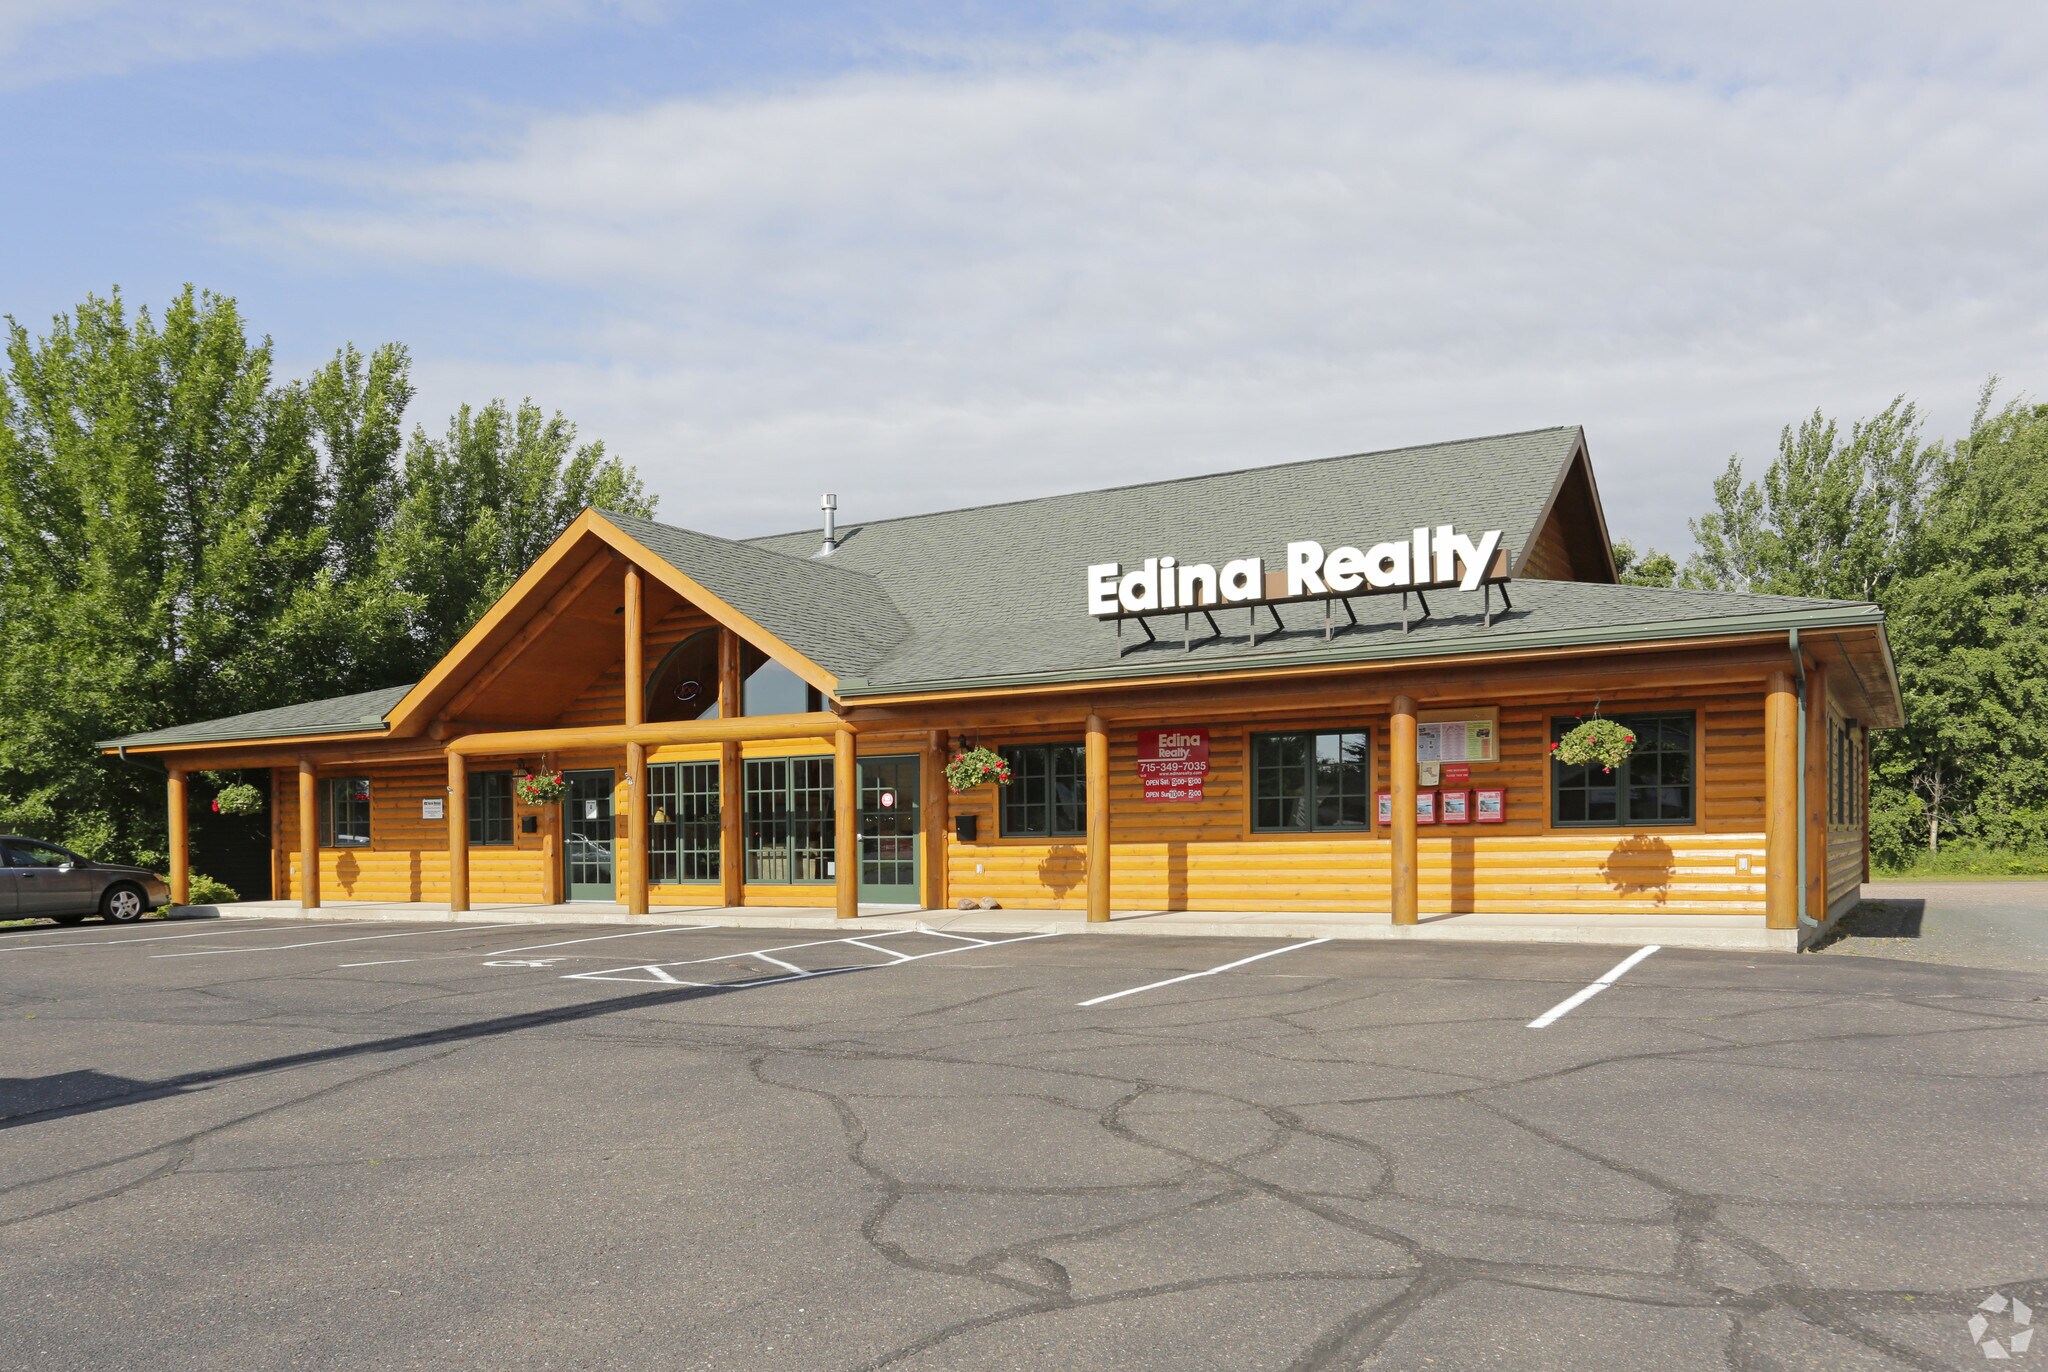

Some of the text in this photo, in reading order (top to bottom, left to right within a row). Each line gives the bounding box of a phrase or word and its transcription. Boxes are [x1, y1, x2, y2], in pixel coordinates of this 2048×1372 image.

[1088, 525, 1503, 616] Edina Realty
[1158, 733, 1200, 747] Edina
[1158, 747, 1190, 760] Realty
[1140, 762, 1206, 772] 715-349-7035
